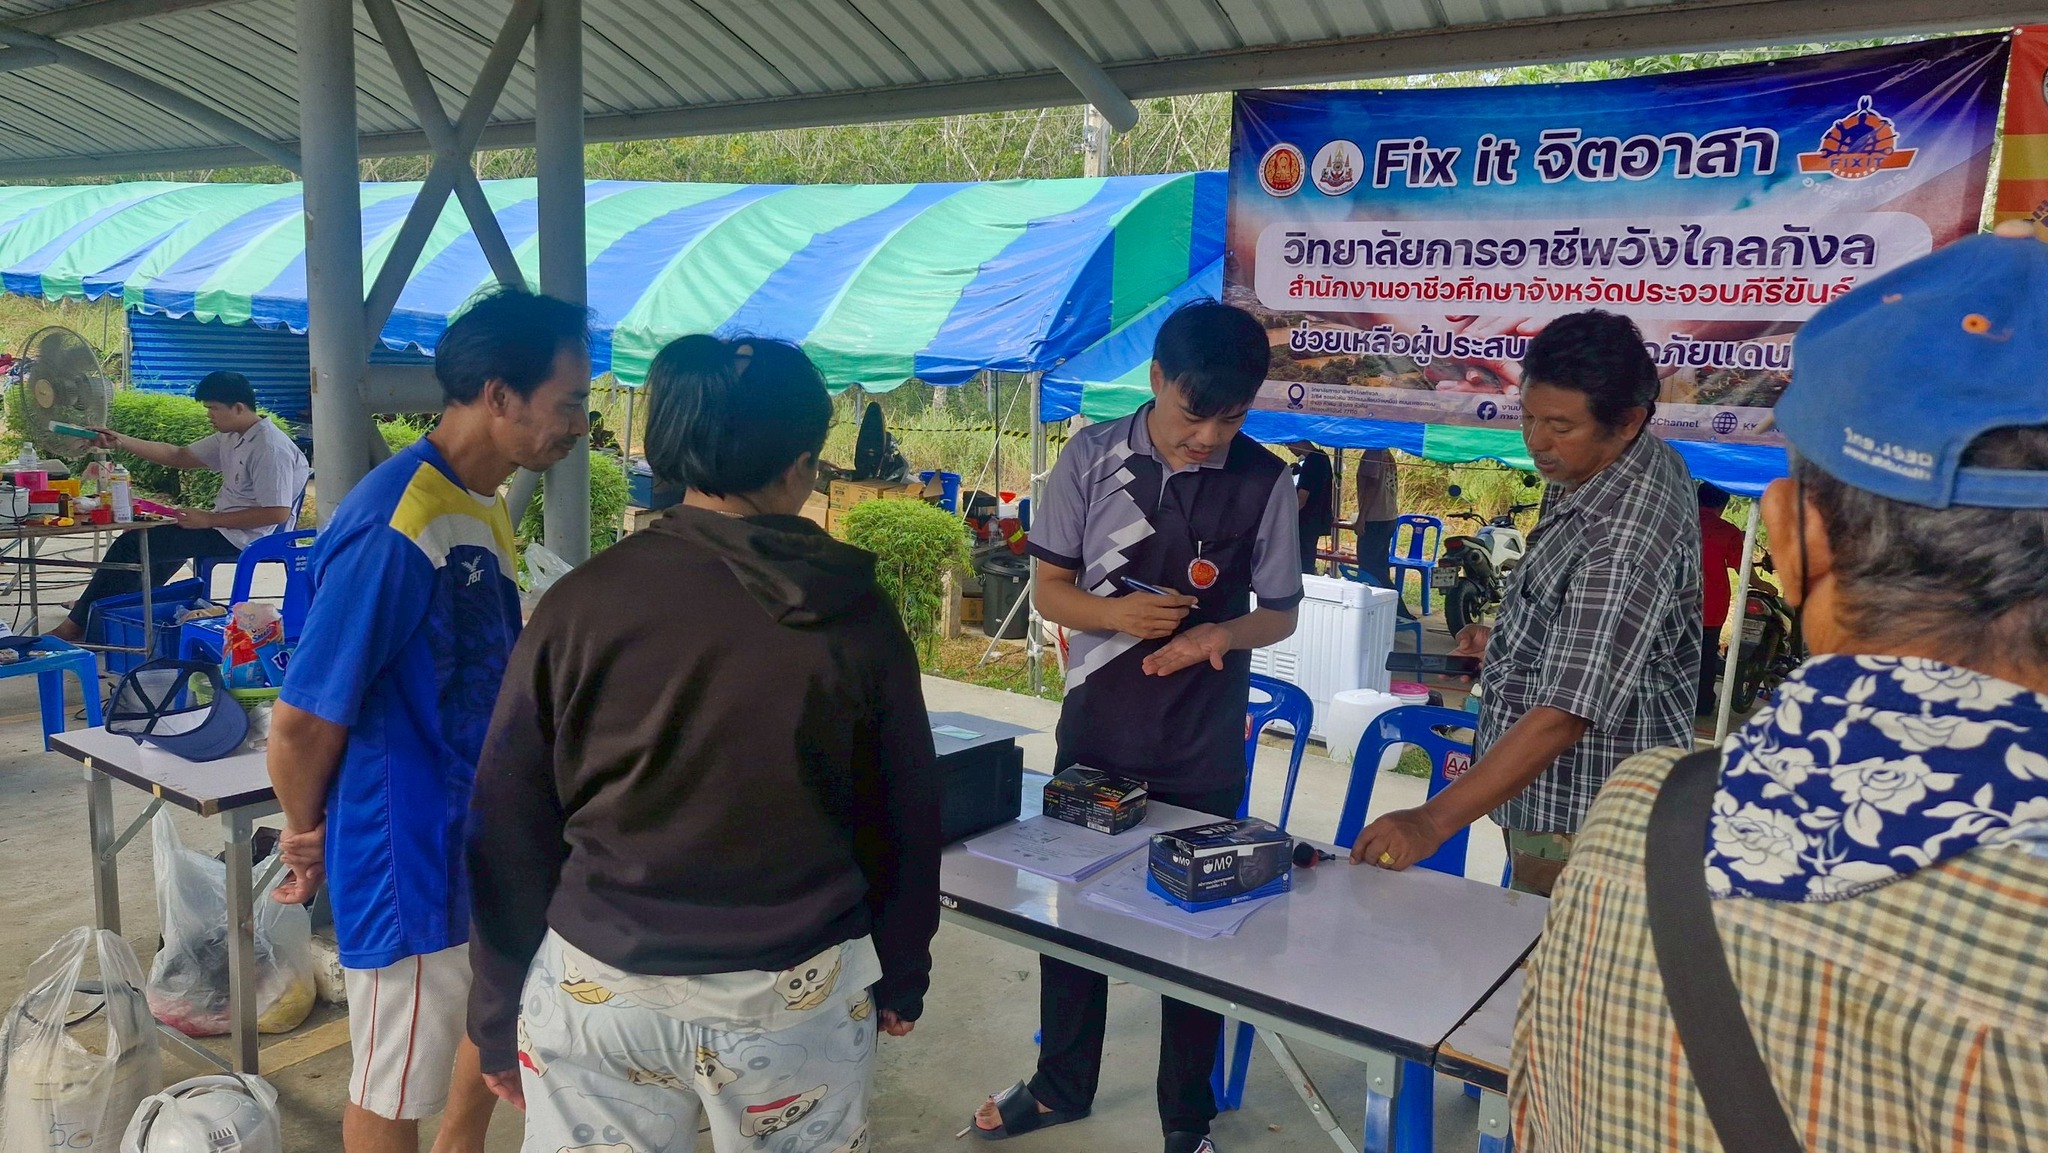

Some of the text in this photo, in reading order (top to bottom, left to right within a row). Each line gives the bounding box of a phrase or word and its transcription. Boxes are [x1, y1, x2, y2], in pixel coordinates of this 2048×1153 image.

[1375, 128, 1778, 187] Fix it จิตอาสา
[1829, 157, 1885, 168] FIXIT
[465, 569, 485, 587] FBT
[1213, 855, 1233, 872] M9
